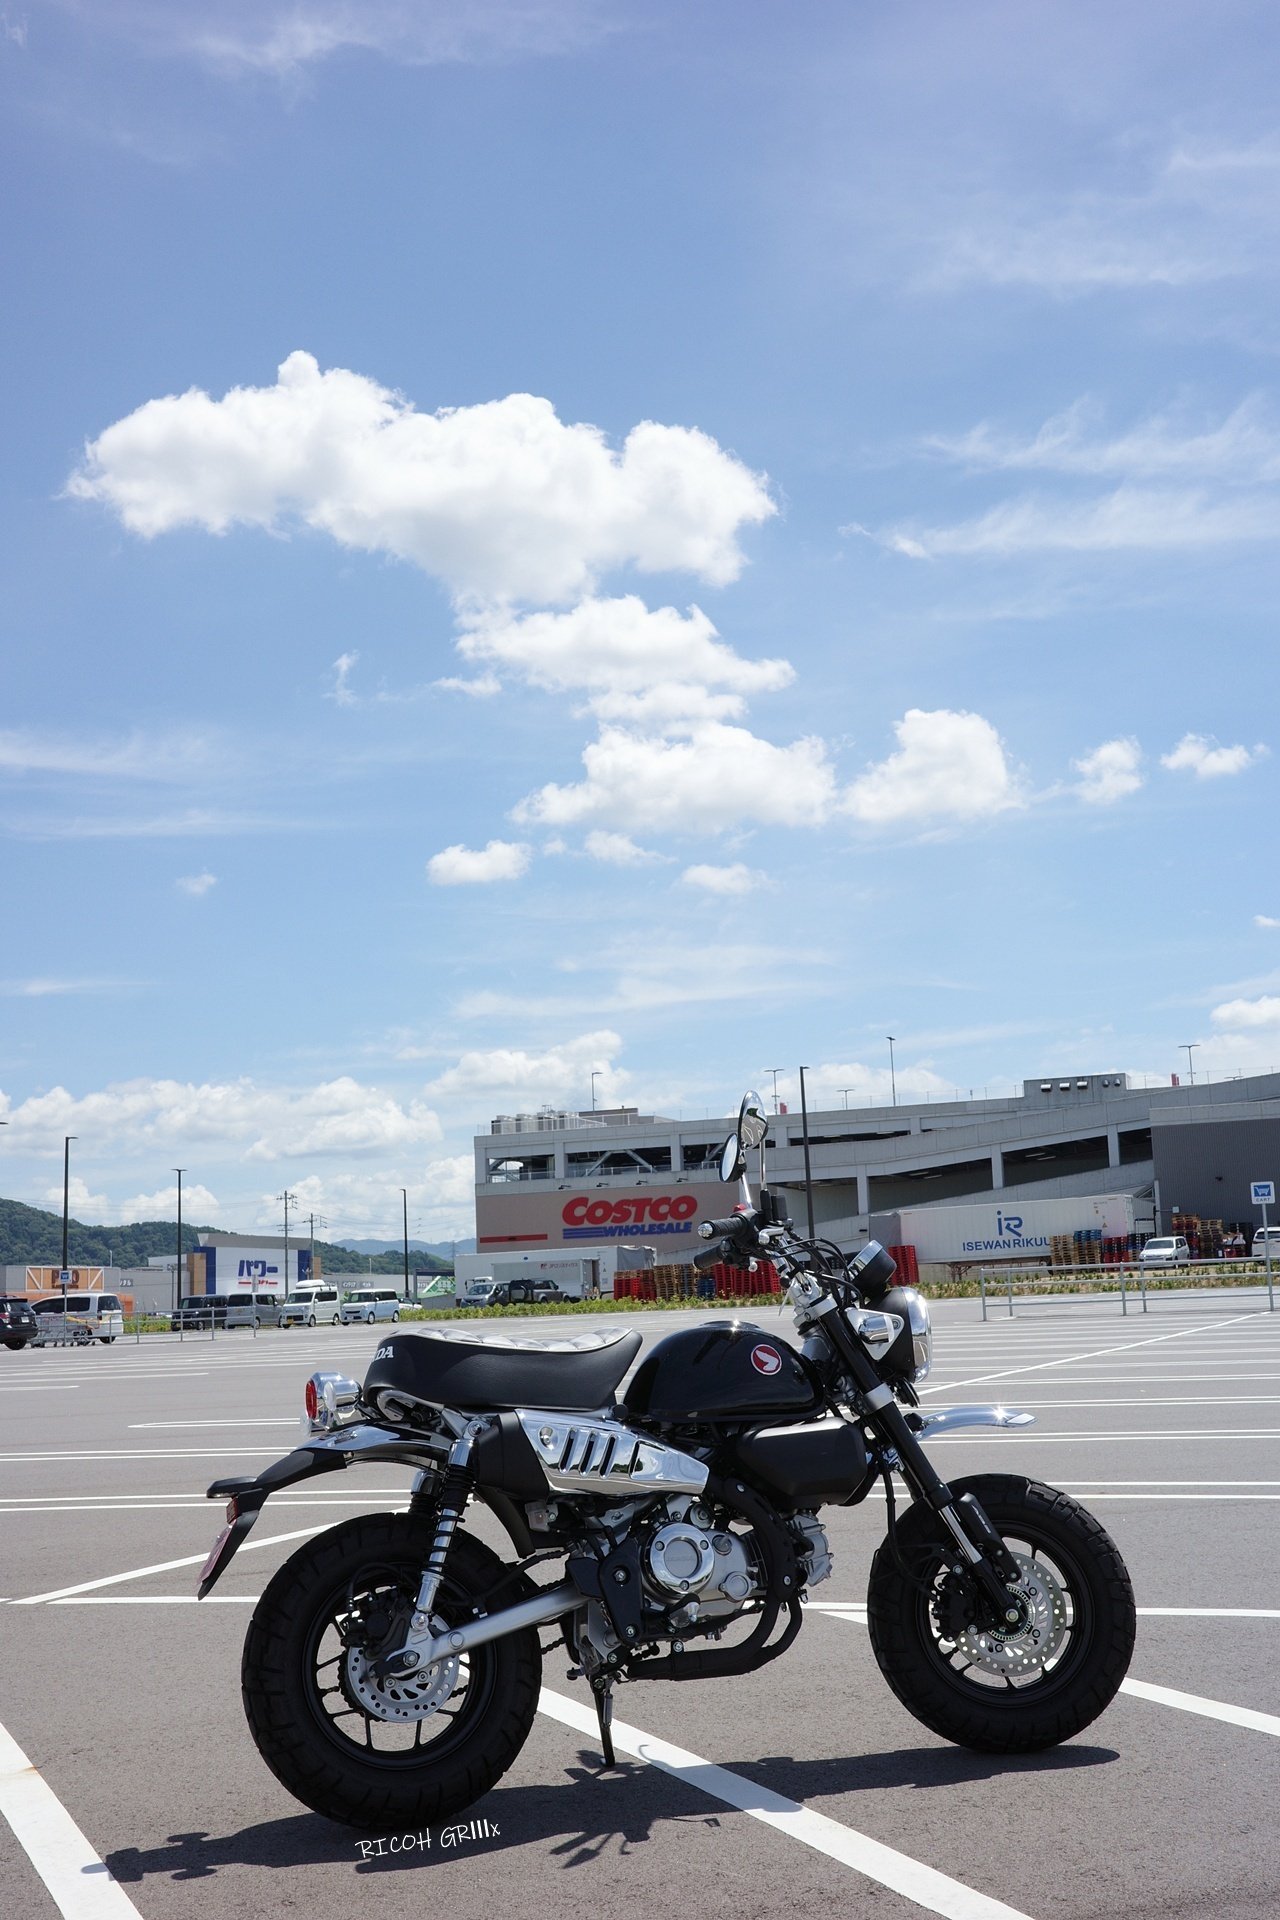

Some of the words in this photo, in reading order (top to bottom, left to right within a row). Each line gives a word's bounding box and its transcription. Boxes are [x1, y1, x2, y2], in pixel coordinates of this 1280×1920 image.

[562, 1195, 698, 1226] COSTCO
[602, 1222, 693, 1237] WHOLESALE
[962, 1239, 1011, 1252] ISEWAN
[1013, 1236, 1051, 1249] RIKUU
[238, 1260, 278, 1277] パワー
[374, 1346, 394, 1361] DA
